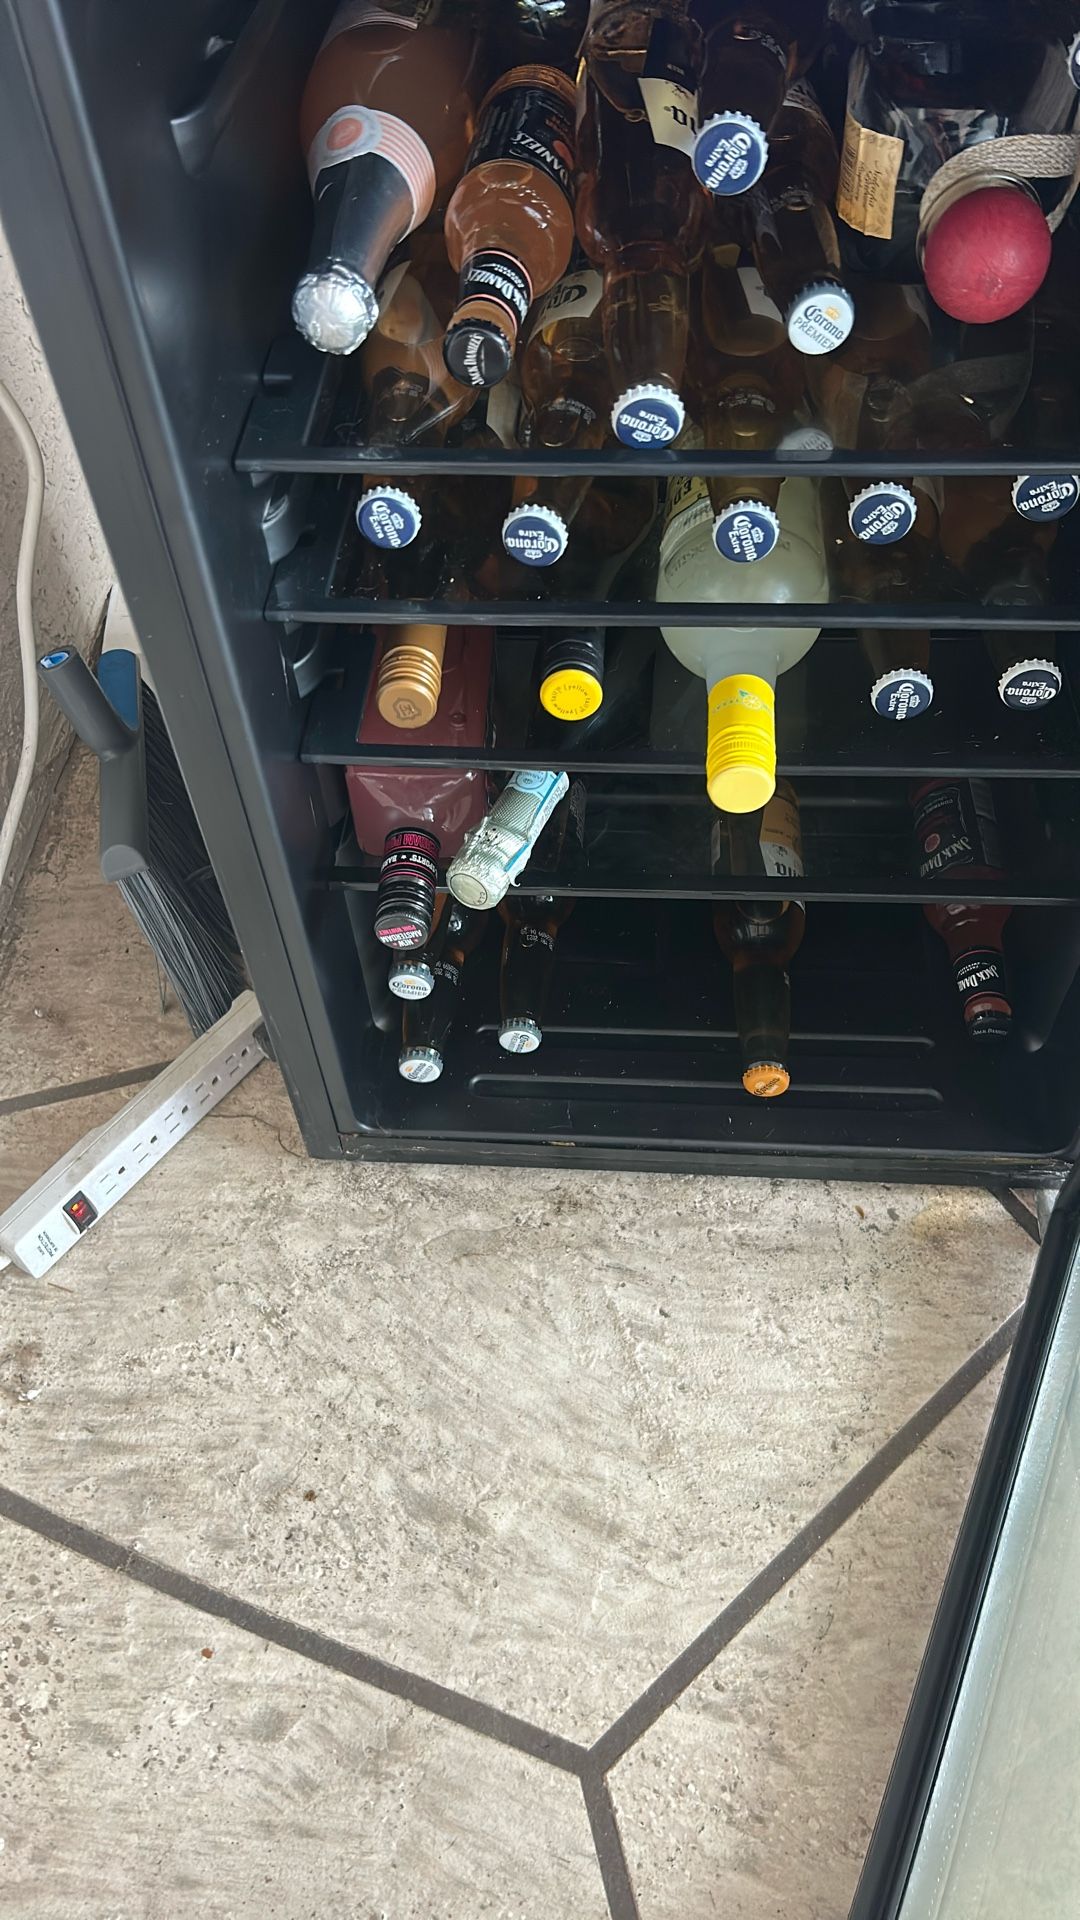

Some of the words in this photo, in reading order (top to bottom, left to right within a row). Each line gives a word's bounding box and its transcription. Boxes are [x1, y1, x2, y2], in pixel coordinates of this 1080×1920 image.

[704, 138, 731, 168] Extra
[704, 132, 752, 189] Corona
[793, 316, 836, 350] PREMIER
[803, 304, 844, 340] Corona
[463, 332, 485, 366] DANIEL'S
[466, 365, 485, 386] JACK
[618, 413, 675, 441] Corona
[638, 409, 667, 427] Extra
[1018, 482, 1075, 511] Corona
[1029, 480, 1058, 496] Extra
[371, 500, 402, 548] Corona
[858, 501, 906, 540] Corona
[861, 504, 888, 524] Extra
[369, 515, 385, 539] Extra
[518, 529, 545, 541] Extra
[505, 536, 560, 553] Corona
[728, 530, 741, 555] Extra
[733, 515, 758, 562] Corona
[1005, 686, 1057, 700] Corona
[1022, 681, 1047, 690] Extra
[887, 692, 901, 712] Extra
[895, 682, 915, 721] Corona
[940, 835, 972, 860] JACK
[379, 929, 423, 944] AMSTERDAM
[398, 938, 415, 948] NEW
[975, 964, 1000, 982] JACK
[391, 987, 427, 996] PREMIER
[392, 981, 428, 992] Corona
